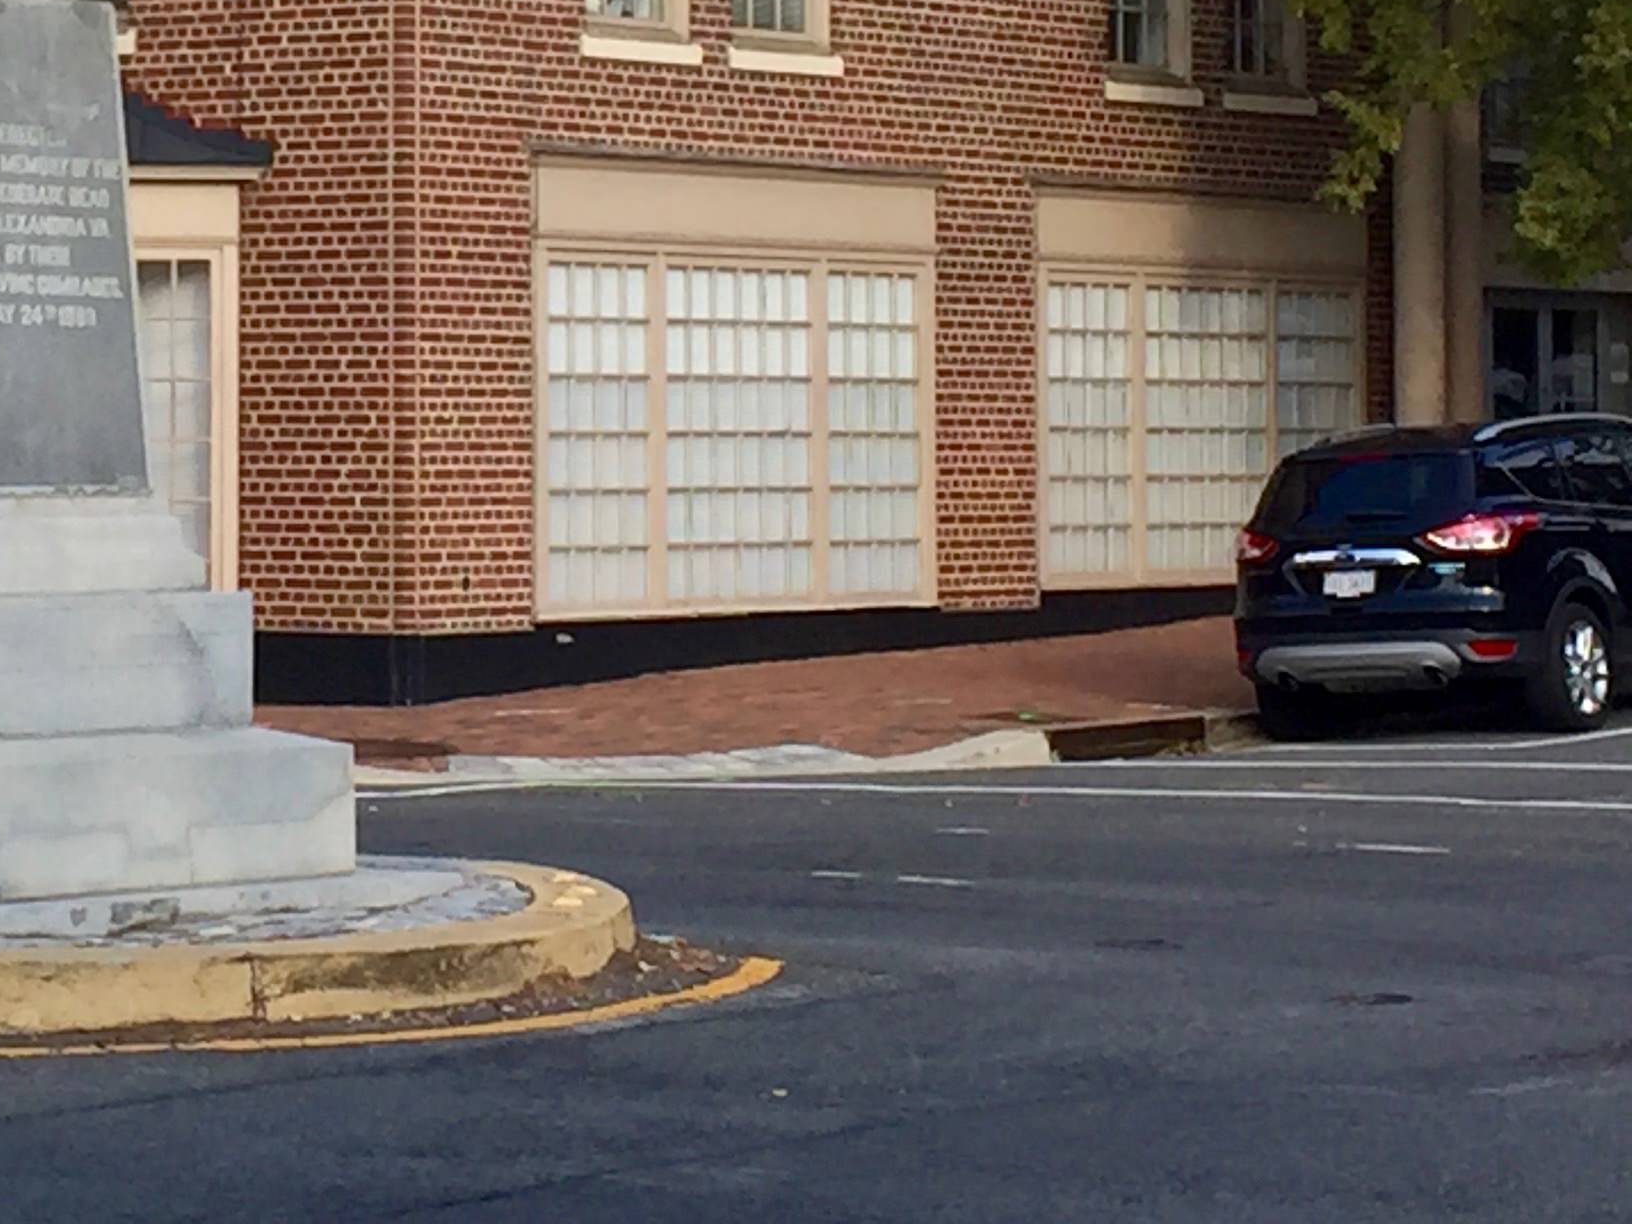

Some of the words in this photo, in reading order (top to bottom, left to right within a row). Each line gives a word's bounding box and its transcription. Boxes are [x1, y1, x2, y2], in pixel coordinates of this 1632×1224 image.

[0, 153, 68, 177] MEMORY
[71, 157, 90, 178] OF
[93, 158, 121, 181] THE
[69, 185, 110, 209] DEAD
[4, 243, 26, 265] BY
[28, 244, 71, 267] THEIR
